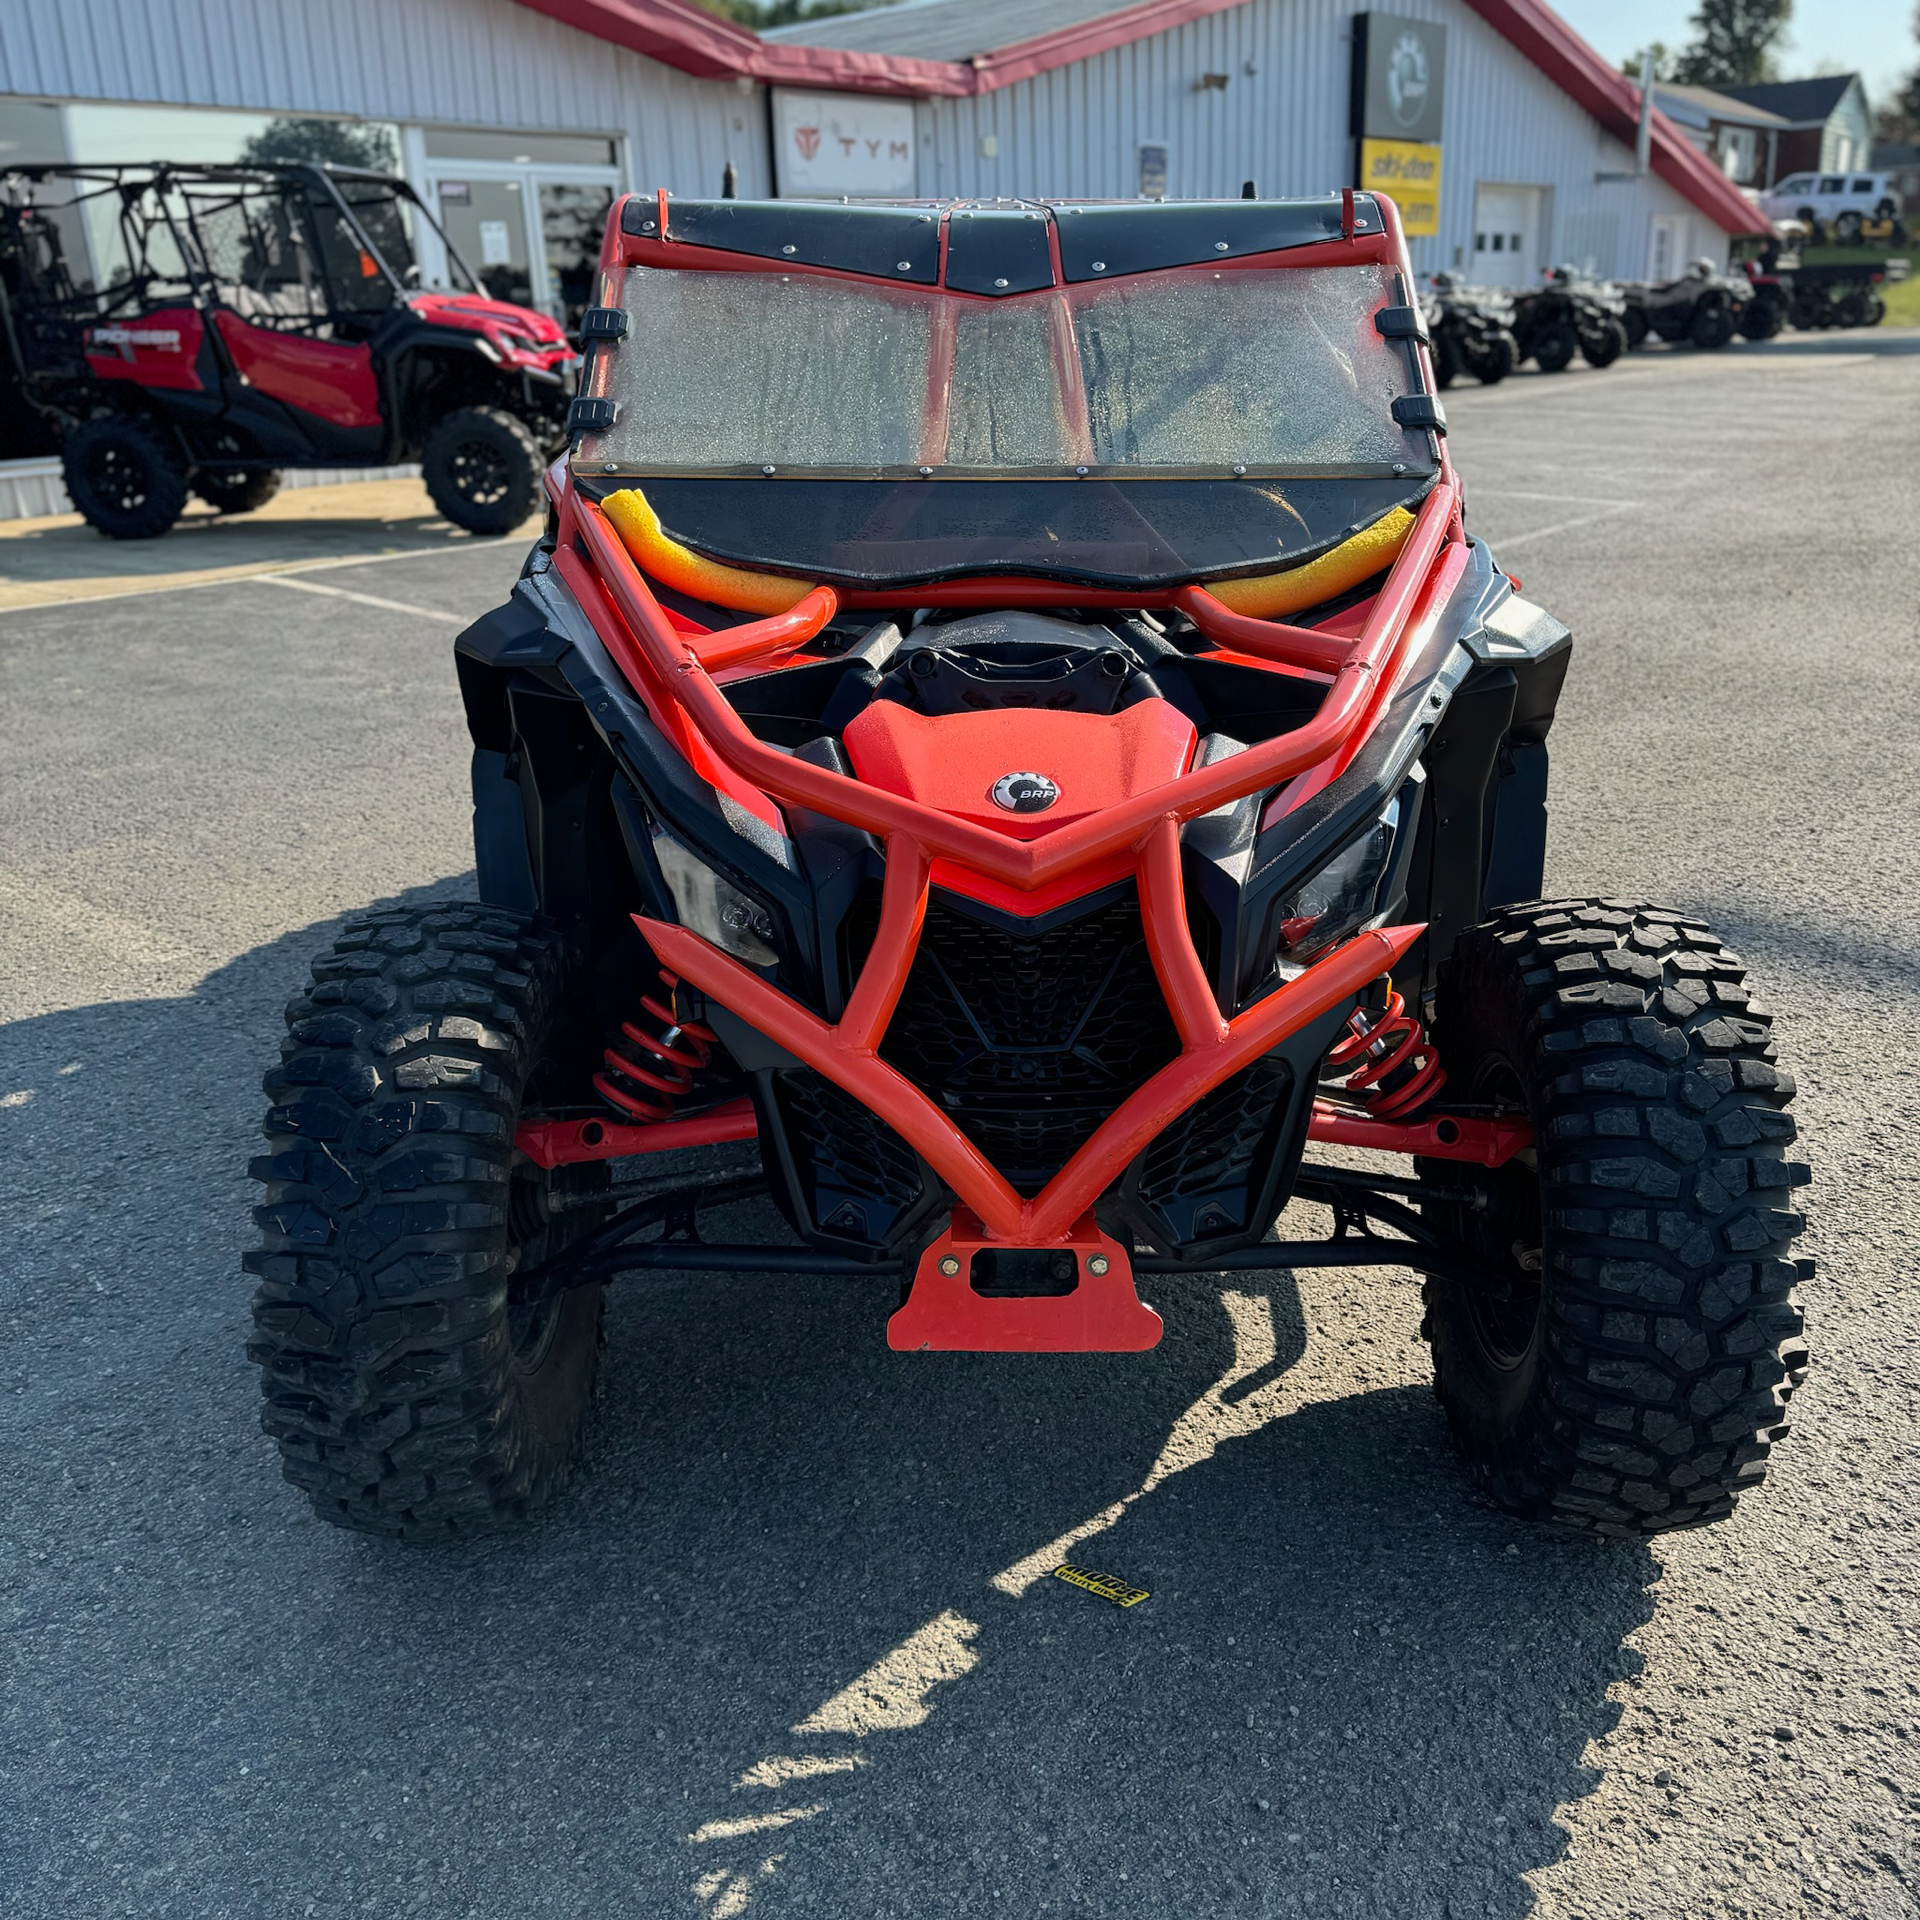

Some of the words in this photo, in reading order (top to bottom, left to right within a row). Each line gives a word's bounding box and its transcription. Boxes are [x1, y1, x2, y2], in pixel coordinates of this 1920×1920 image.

[838, 137, 909, 161] TYM
[1020, 789, 1055, 799] BRP
[1092, 1585, 1129, 1605] DIVISIN
